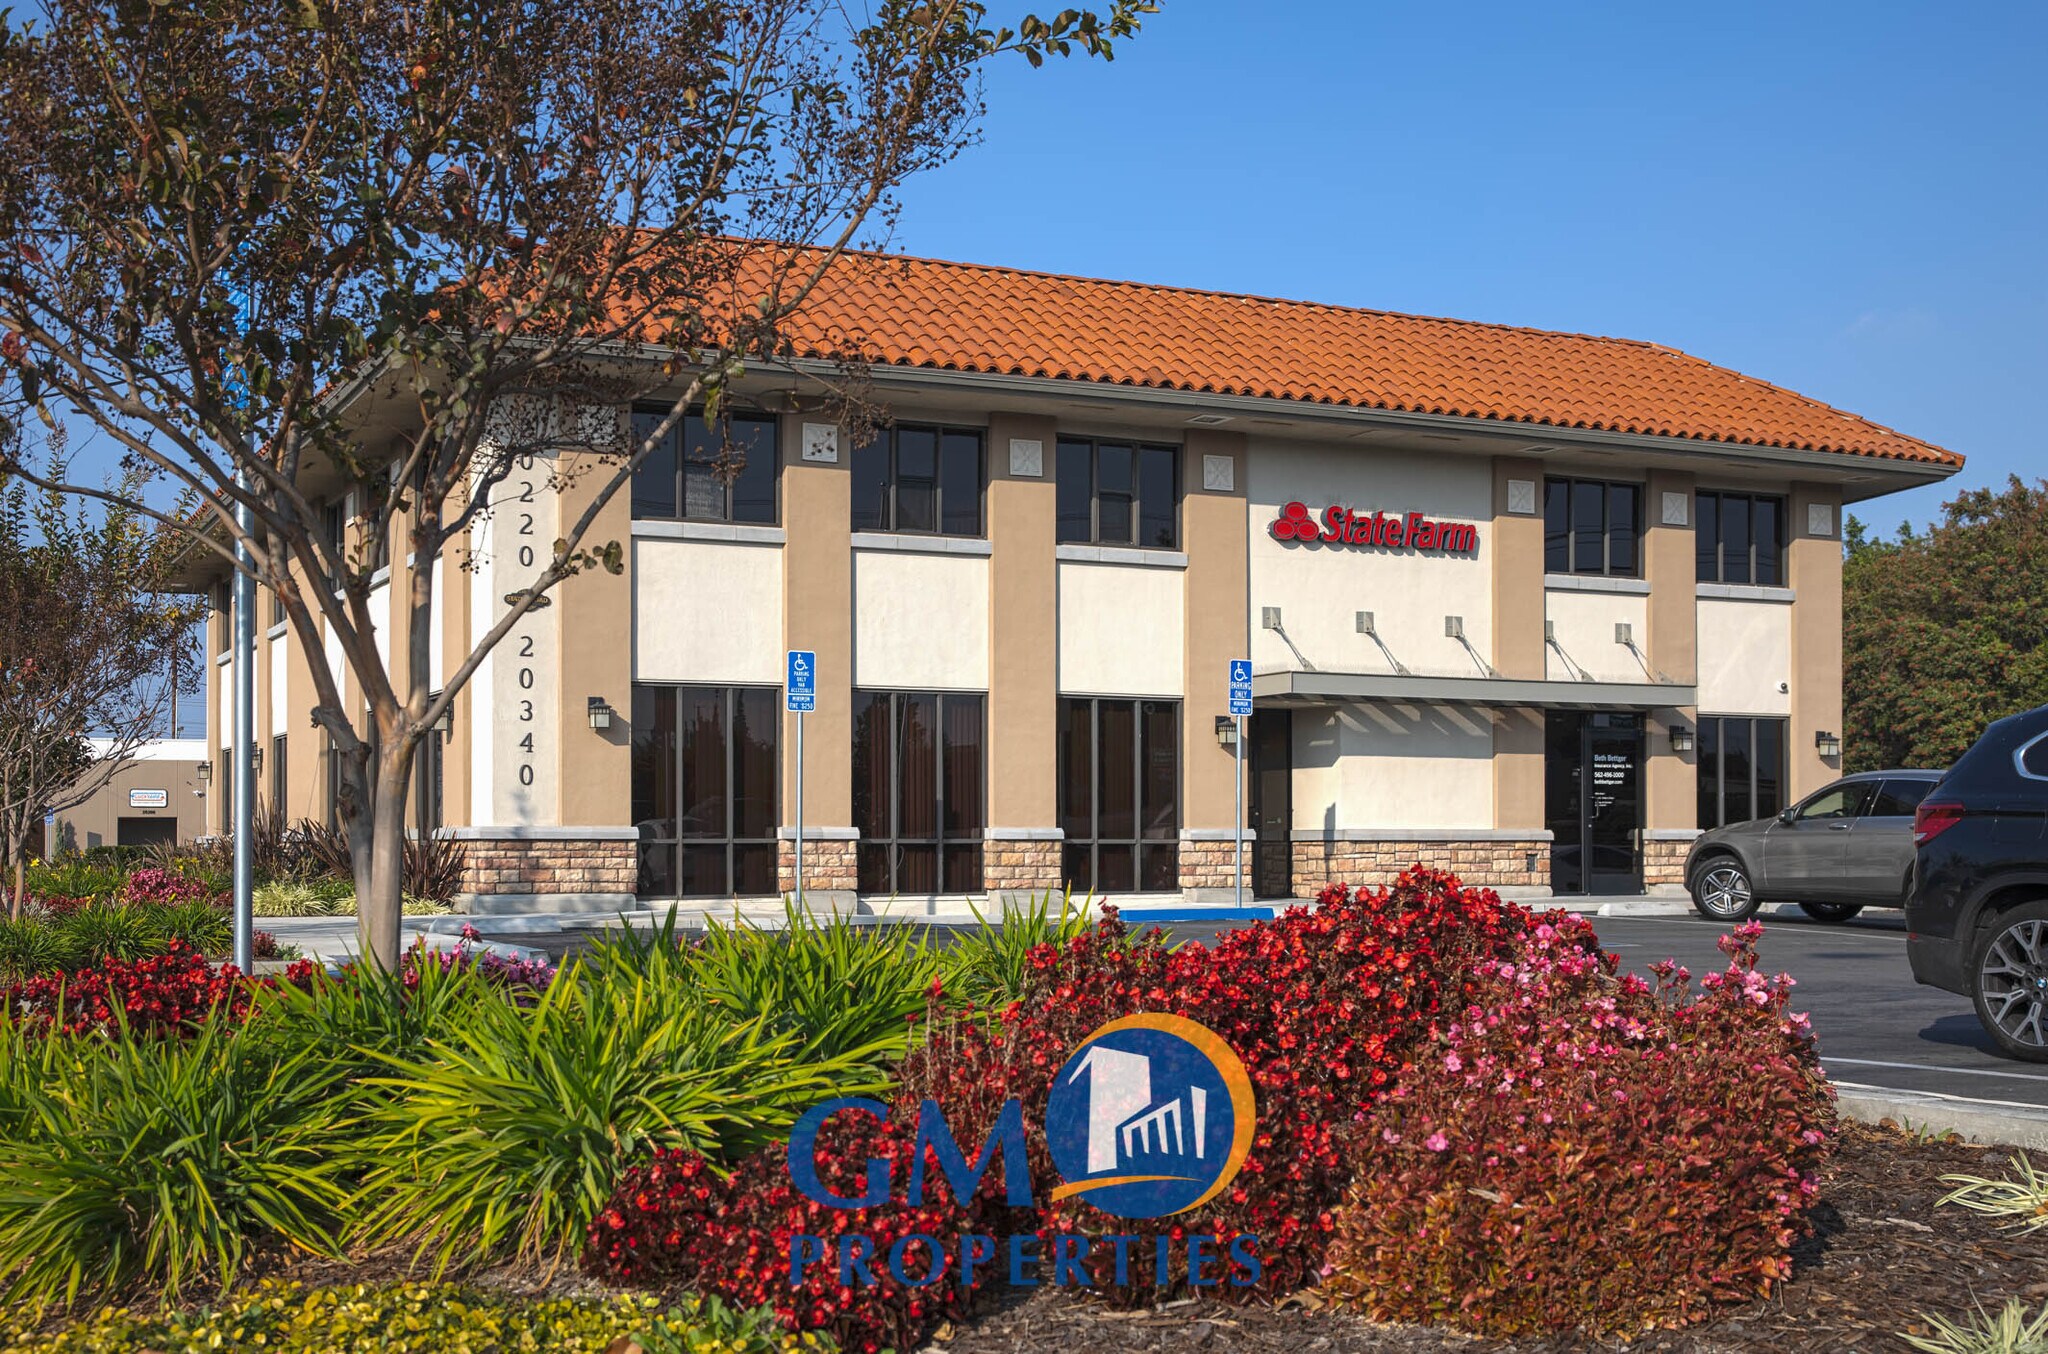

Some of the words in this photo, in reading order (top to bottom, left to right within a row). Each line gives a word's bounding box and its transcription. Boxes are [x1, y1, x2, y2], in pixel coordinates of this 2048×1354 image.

[1231, 681, 1251, 690] PARKING
[1235, 690, 1248, 698] ONLY
[518, 636, 534, 786] 20340
[1594, 754, 1607, 762] Beth
